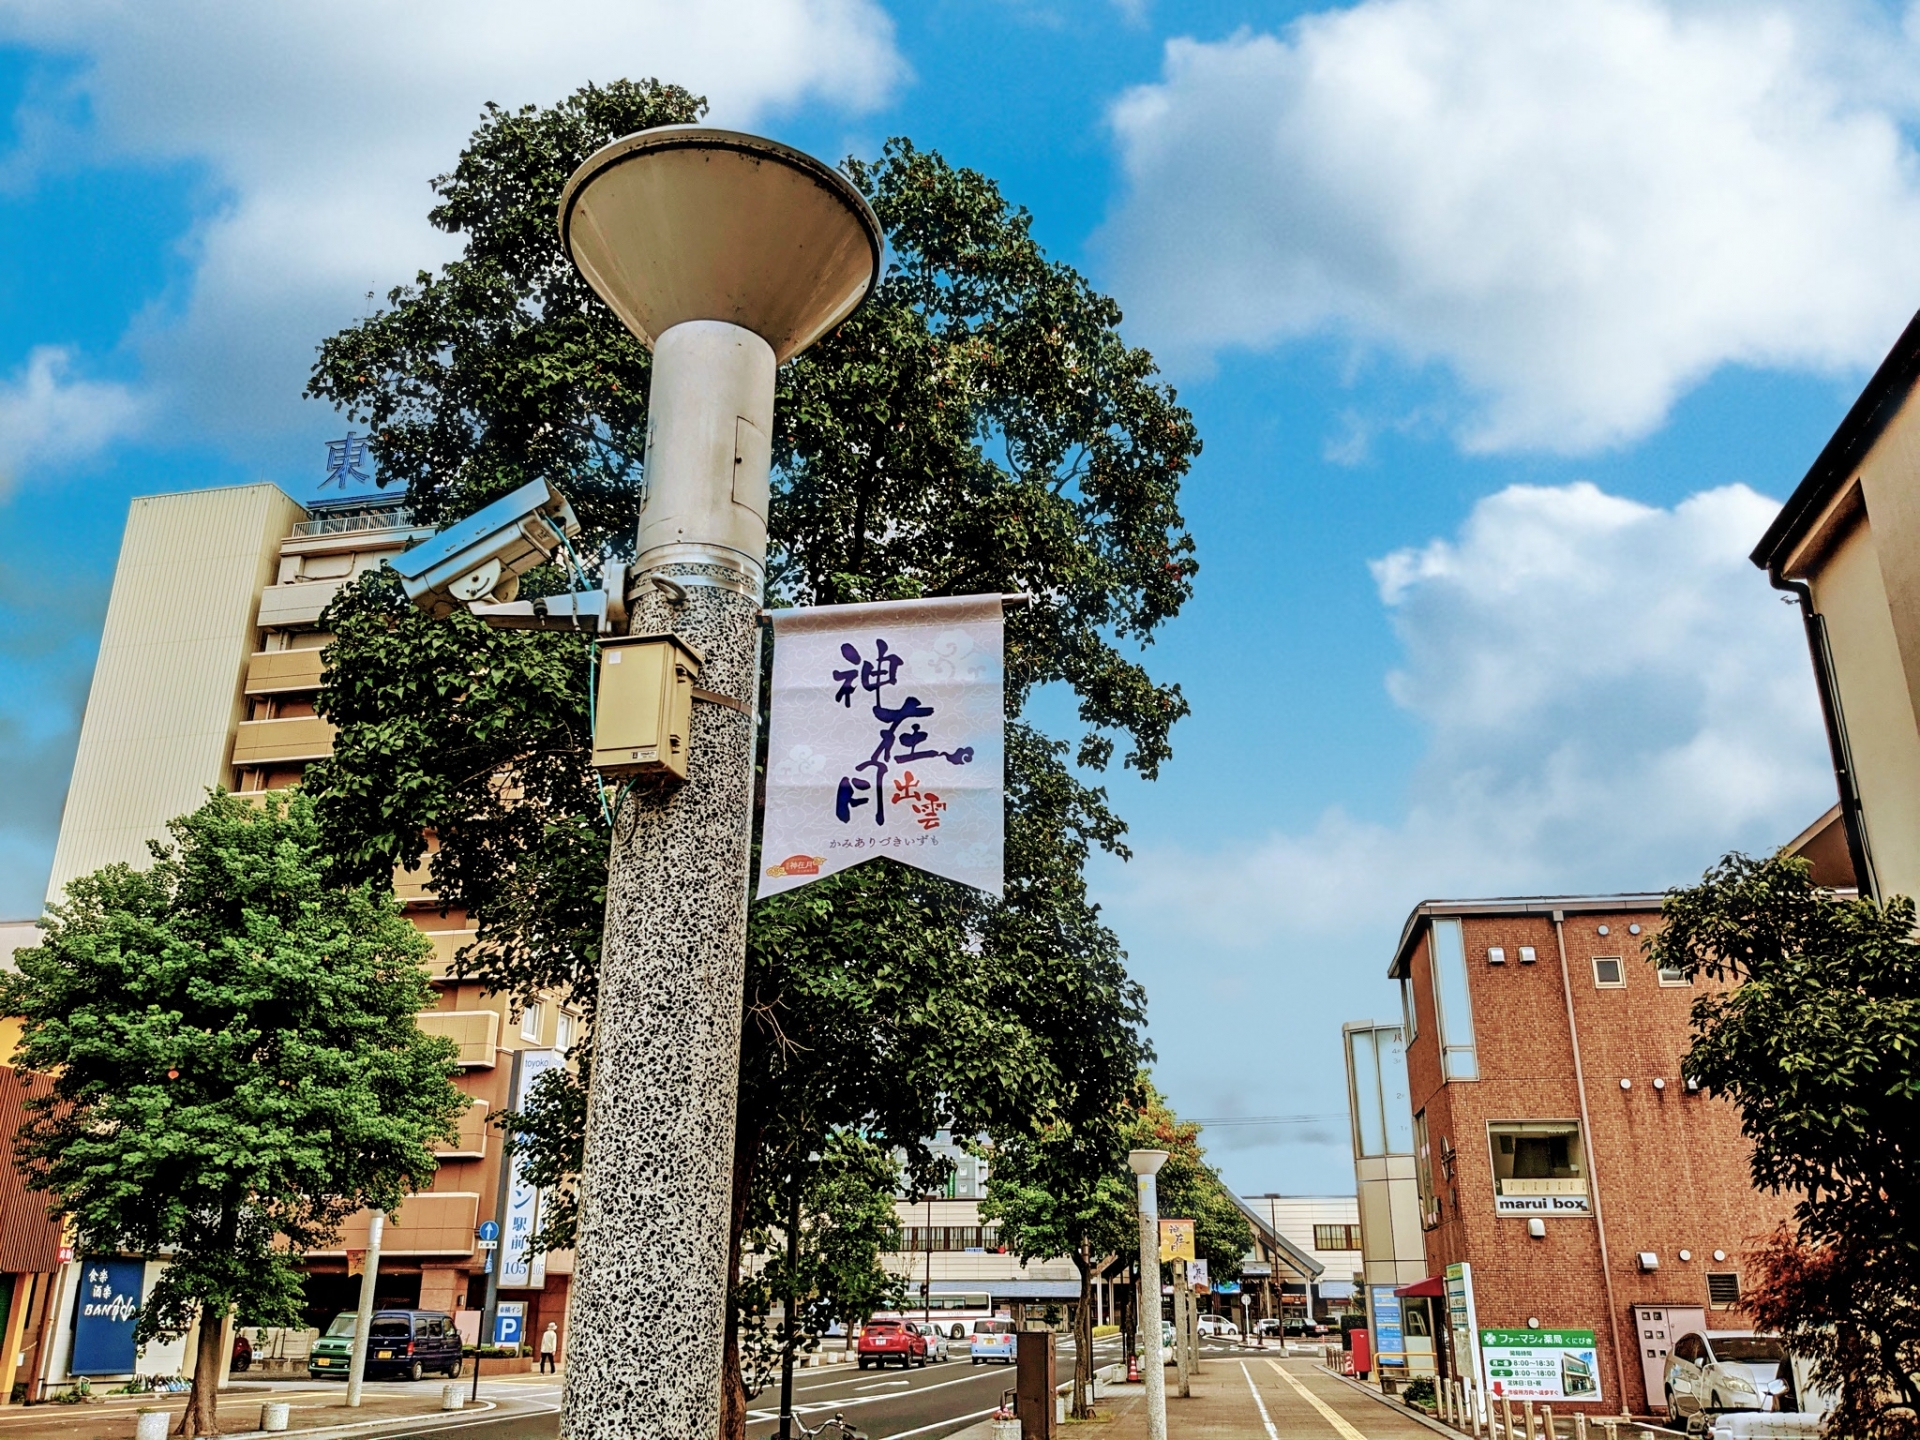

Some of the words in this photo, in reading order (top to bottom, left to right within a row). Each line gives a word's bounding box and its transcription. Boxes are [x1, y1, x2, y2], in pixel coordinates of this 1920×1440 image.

[317, 431, 371, 490] 東
[832, 638, 970, 826] 神在月
[891, 770, 948, 830] 出雲
[829, 834, 940, 849] かみありづきいずも
[525, 1058, 549, 1069] toyoko
[1499, 1198, 1547, 1209] marui
[1552, 1198, 1585, 1209] box
[504, 1261, 527, 1275] 105
[532, 1263, 544, 1276] 105
[500, 1318, 517, 1341] P
[1565, 1337, 1593, 1345] くにびき
